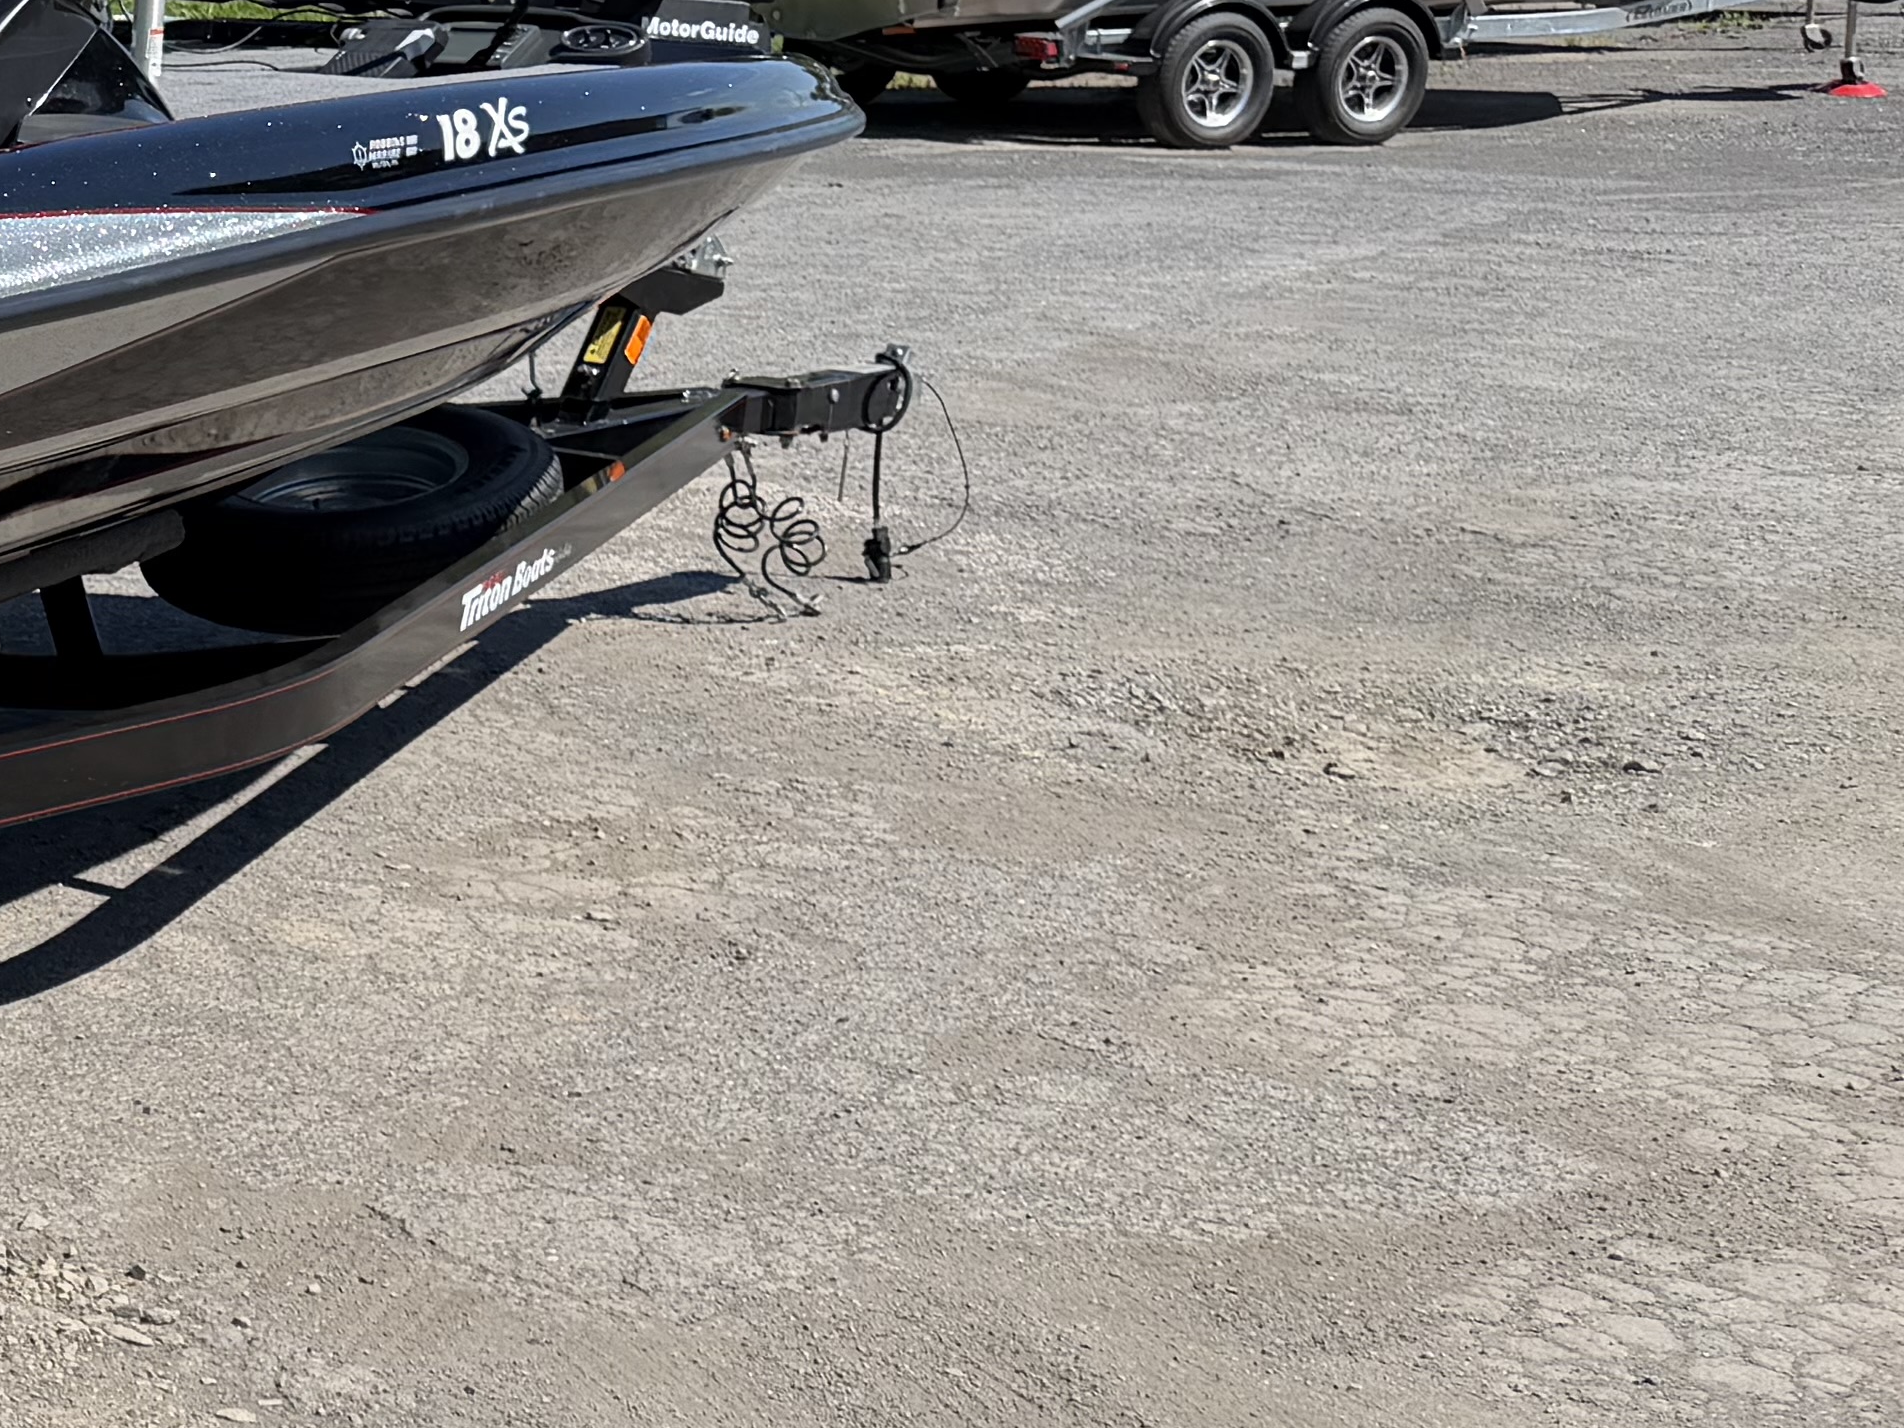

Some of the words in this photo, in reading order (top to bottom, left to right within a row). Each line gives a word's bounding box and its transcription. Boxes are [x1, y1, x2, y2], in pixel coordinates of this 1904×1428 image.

[641, 16, 760, 44] MotorGuide
[436, 108, 481, 162] 18
[459, 575, 512, 632] Triton
[512, 548, 555, 596] Boats
